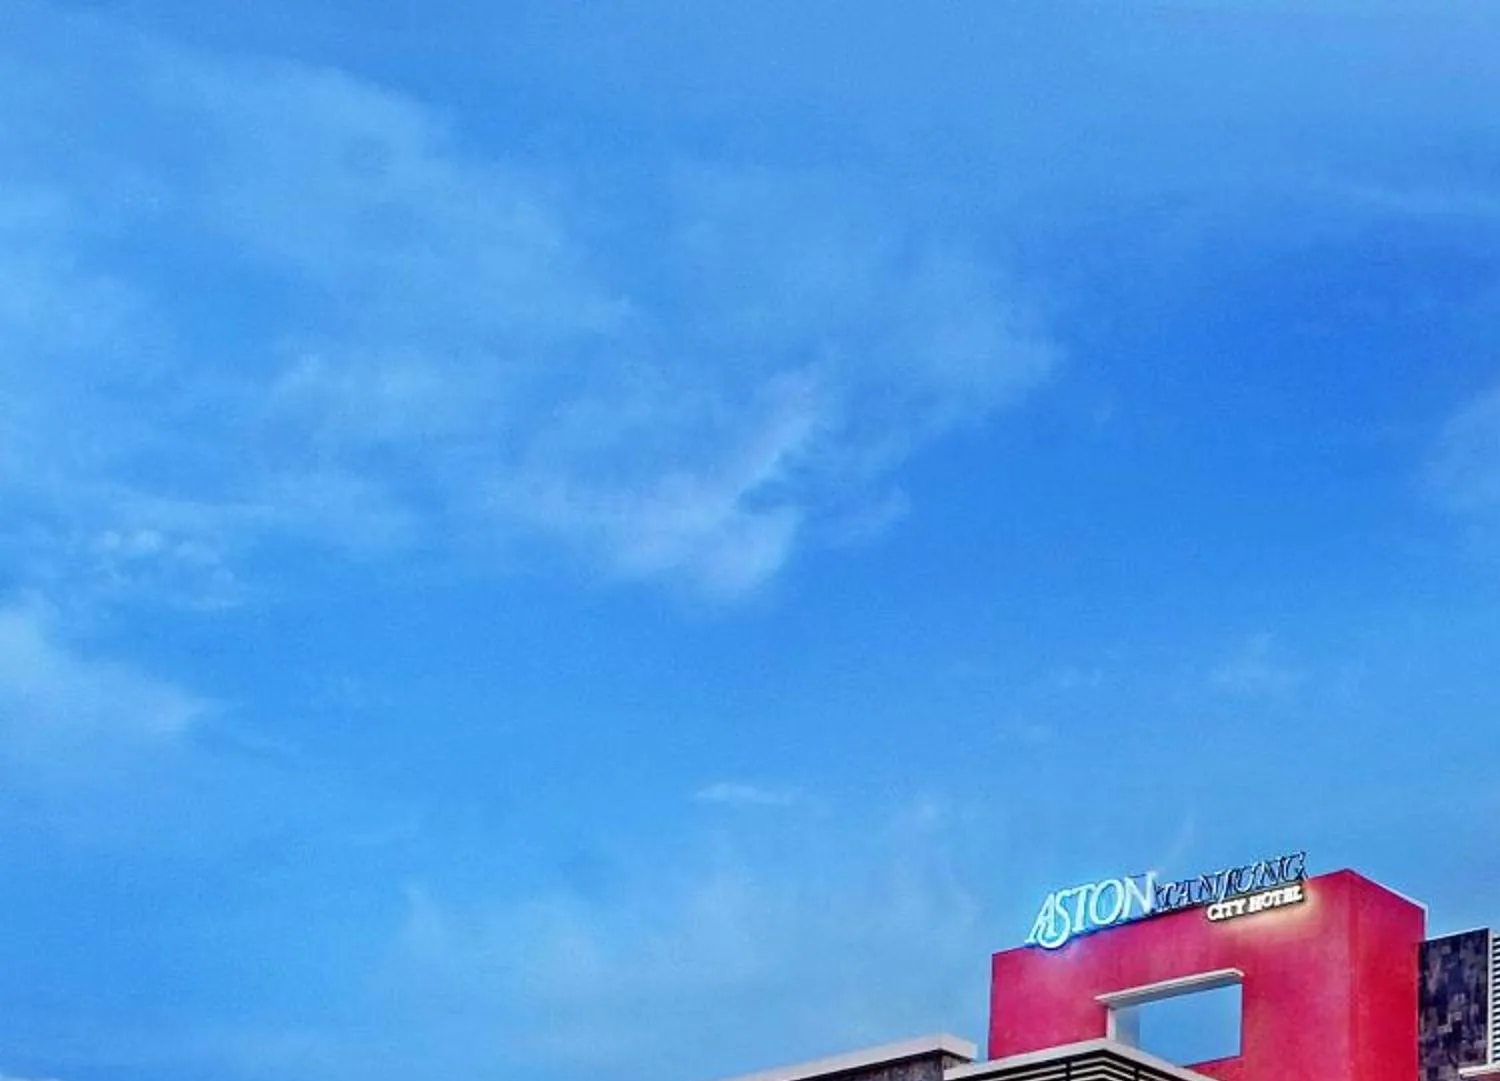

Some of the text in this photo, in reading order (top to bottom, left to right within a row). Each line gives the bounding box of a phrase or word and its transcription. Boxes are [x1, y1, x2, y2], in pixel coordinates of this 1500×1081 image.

[1025, 851, 1308, 949] ASTON TANJUNG
[1207, 885, 1303, 921] CITY HOTEL
